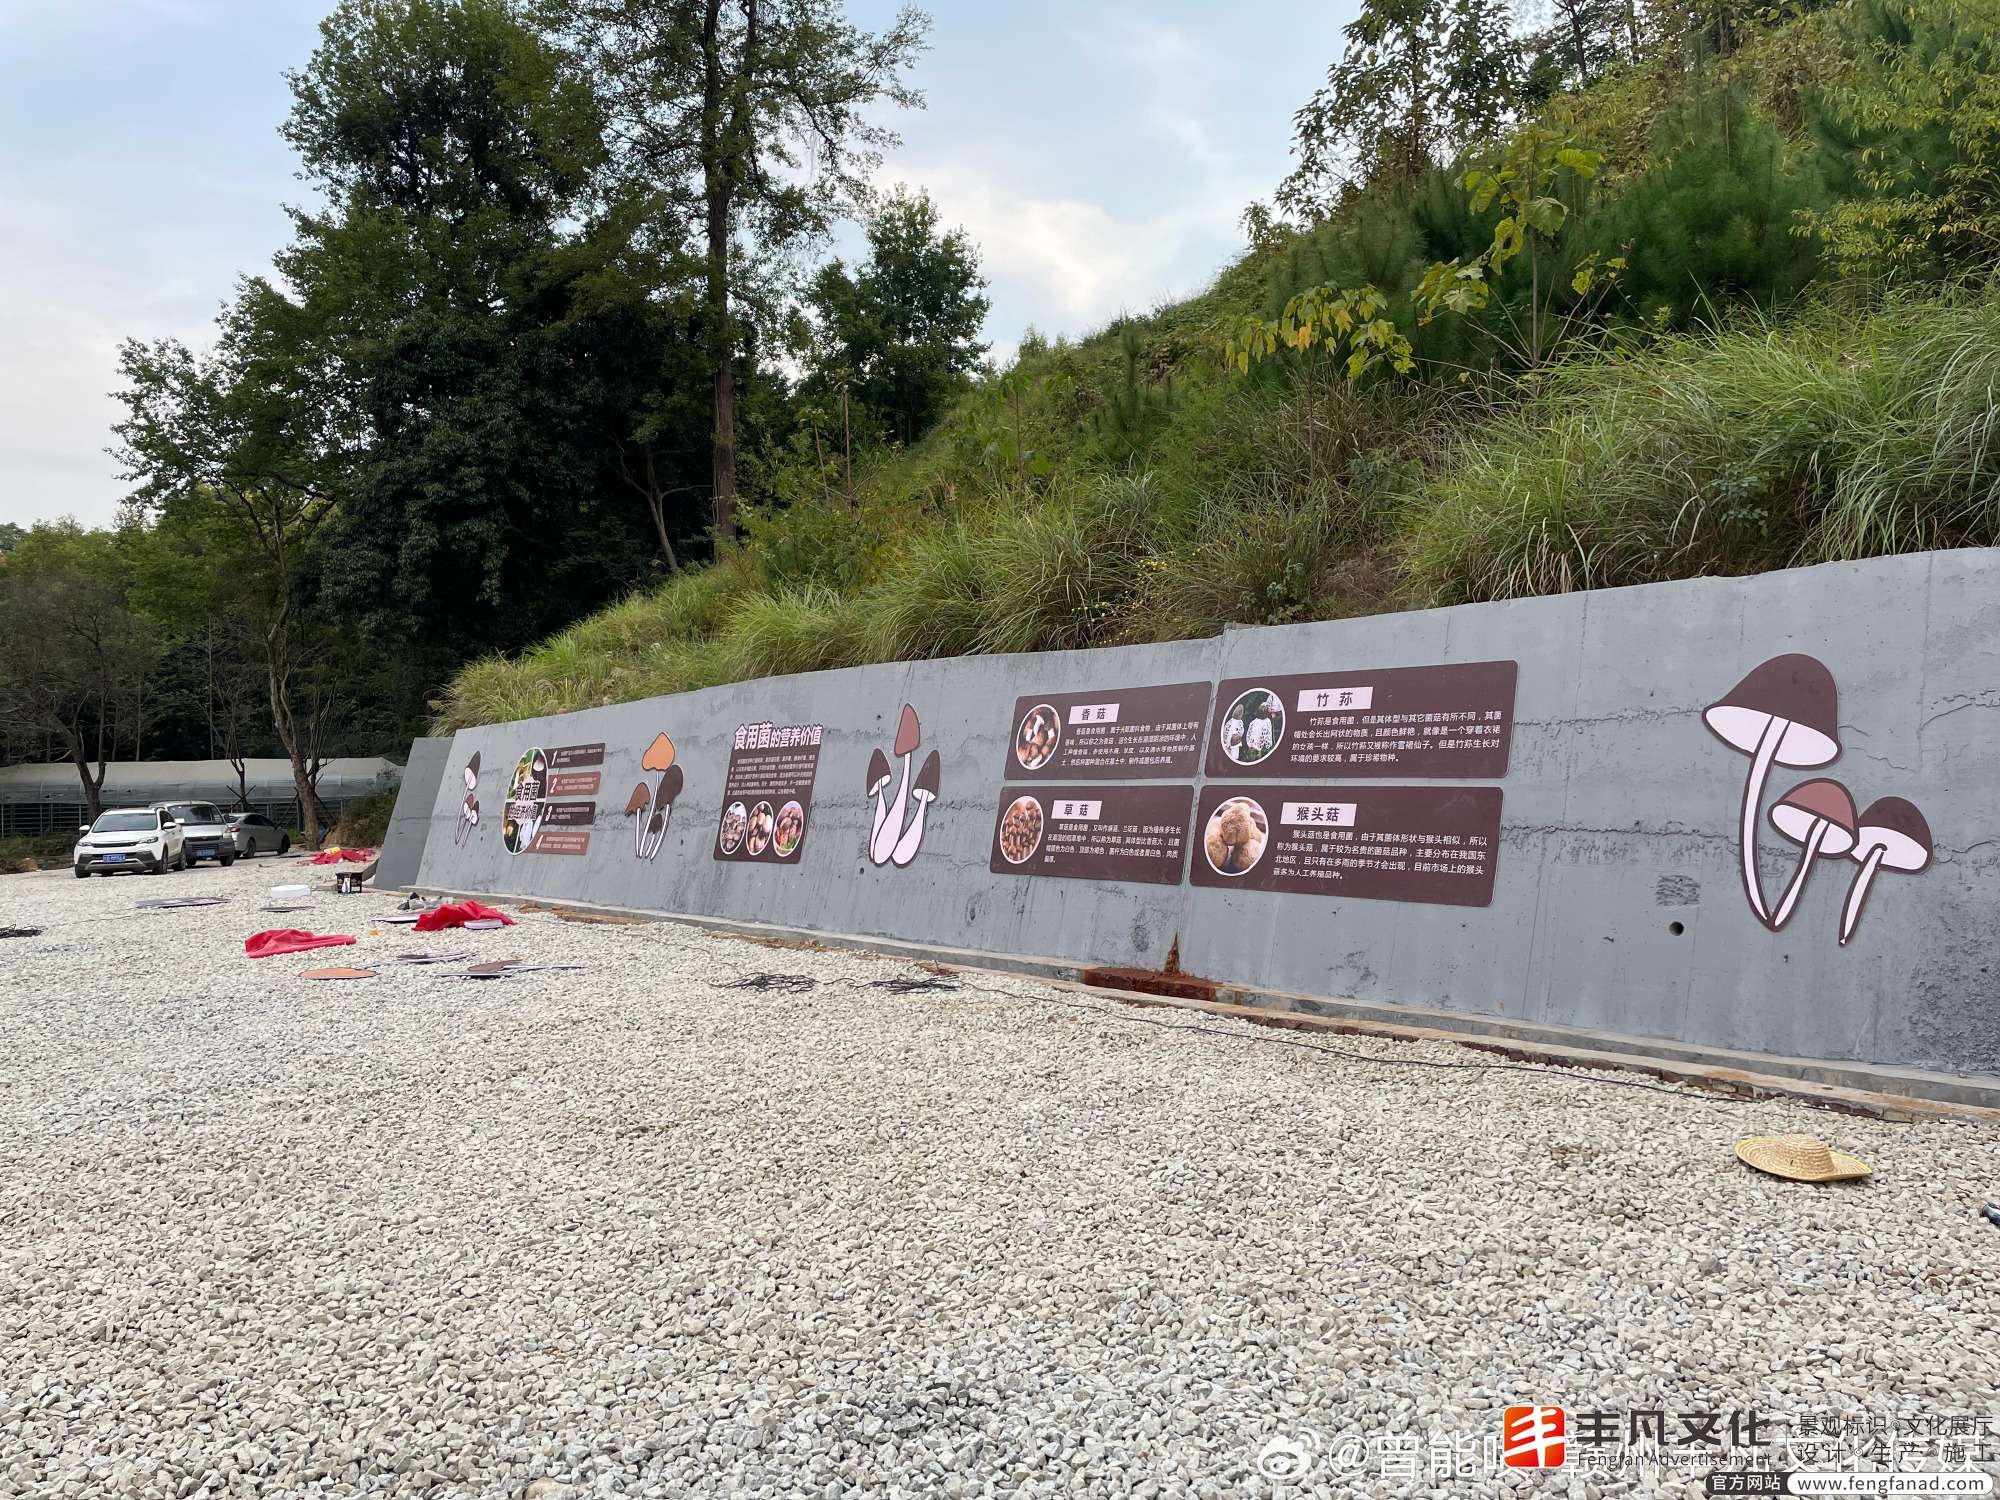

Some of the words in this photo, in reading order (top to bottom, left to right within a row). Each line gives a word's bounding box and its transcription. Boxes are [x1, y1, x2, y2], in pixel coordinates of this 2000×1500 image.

[1316, 692, 1354, 708] 竹荪
[1081, 707, 1106, 721] 香菇
[734, 722, 823, 750] 食用菌的营养价值
[551, 750, 558, 766] 1
[515, 781, 540, 801] 食用菌
[550, 777, 558, 794] 2
[1064, 804, 1089, 816] 草菇
[1297, 806, 1341, 822] 猴头菇
